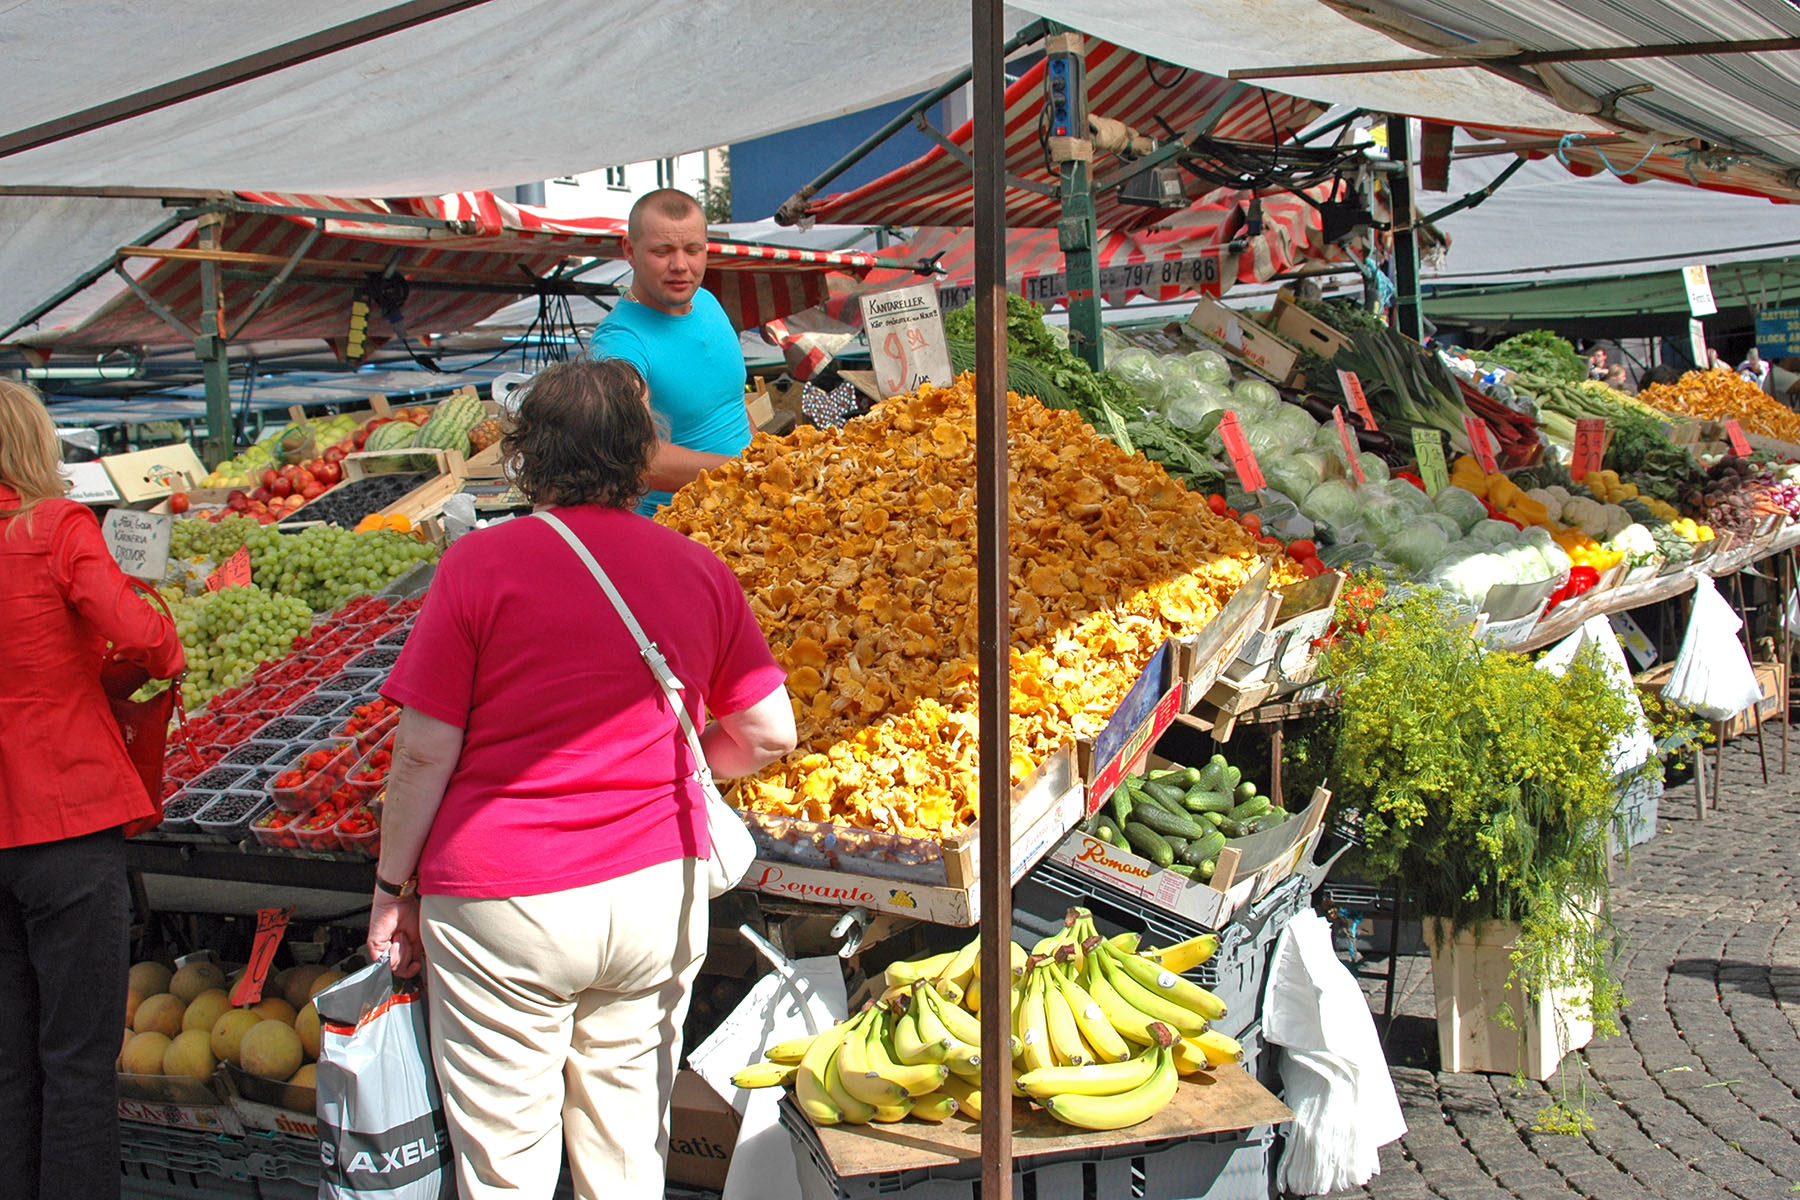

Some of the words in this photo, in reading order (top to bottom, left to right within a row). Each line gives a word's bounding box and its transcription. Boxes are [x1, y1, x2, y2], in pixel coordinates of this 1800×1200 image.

[1029, 276, 1064, 299] TEL.
[1124, 264, 1152, 287] 797
[1162, 261, 1183, 283] 87
[1193, 258, 1215, 282] 86
[869, 296, 926, 315] KANTARELLER
[883, 332, 908, 393] 9
[1579, 433, 1590, 456] 3
[1077, 838, 1151, 879] Romano
[747, 863, 877, 904] Levante
